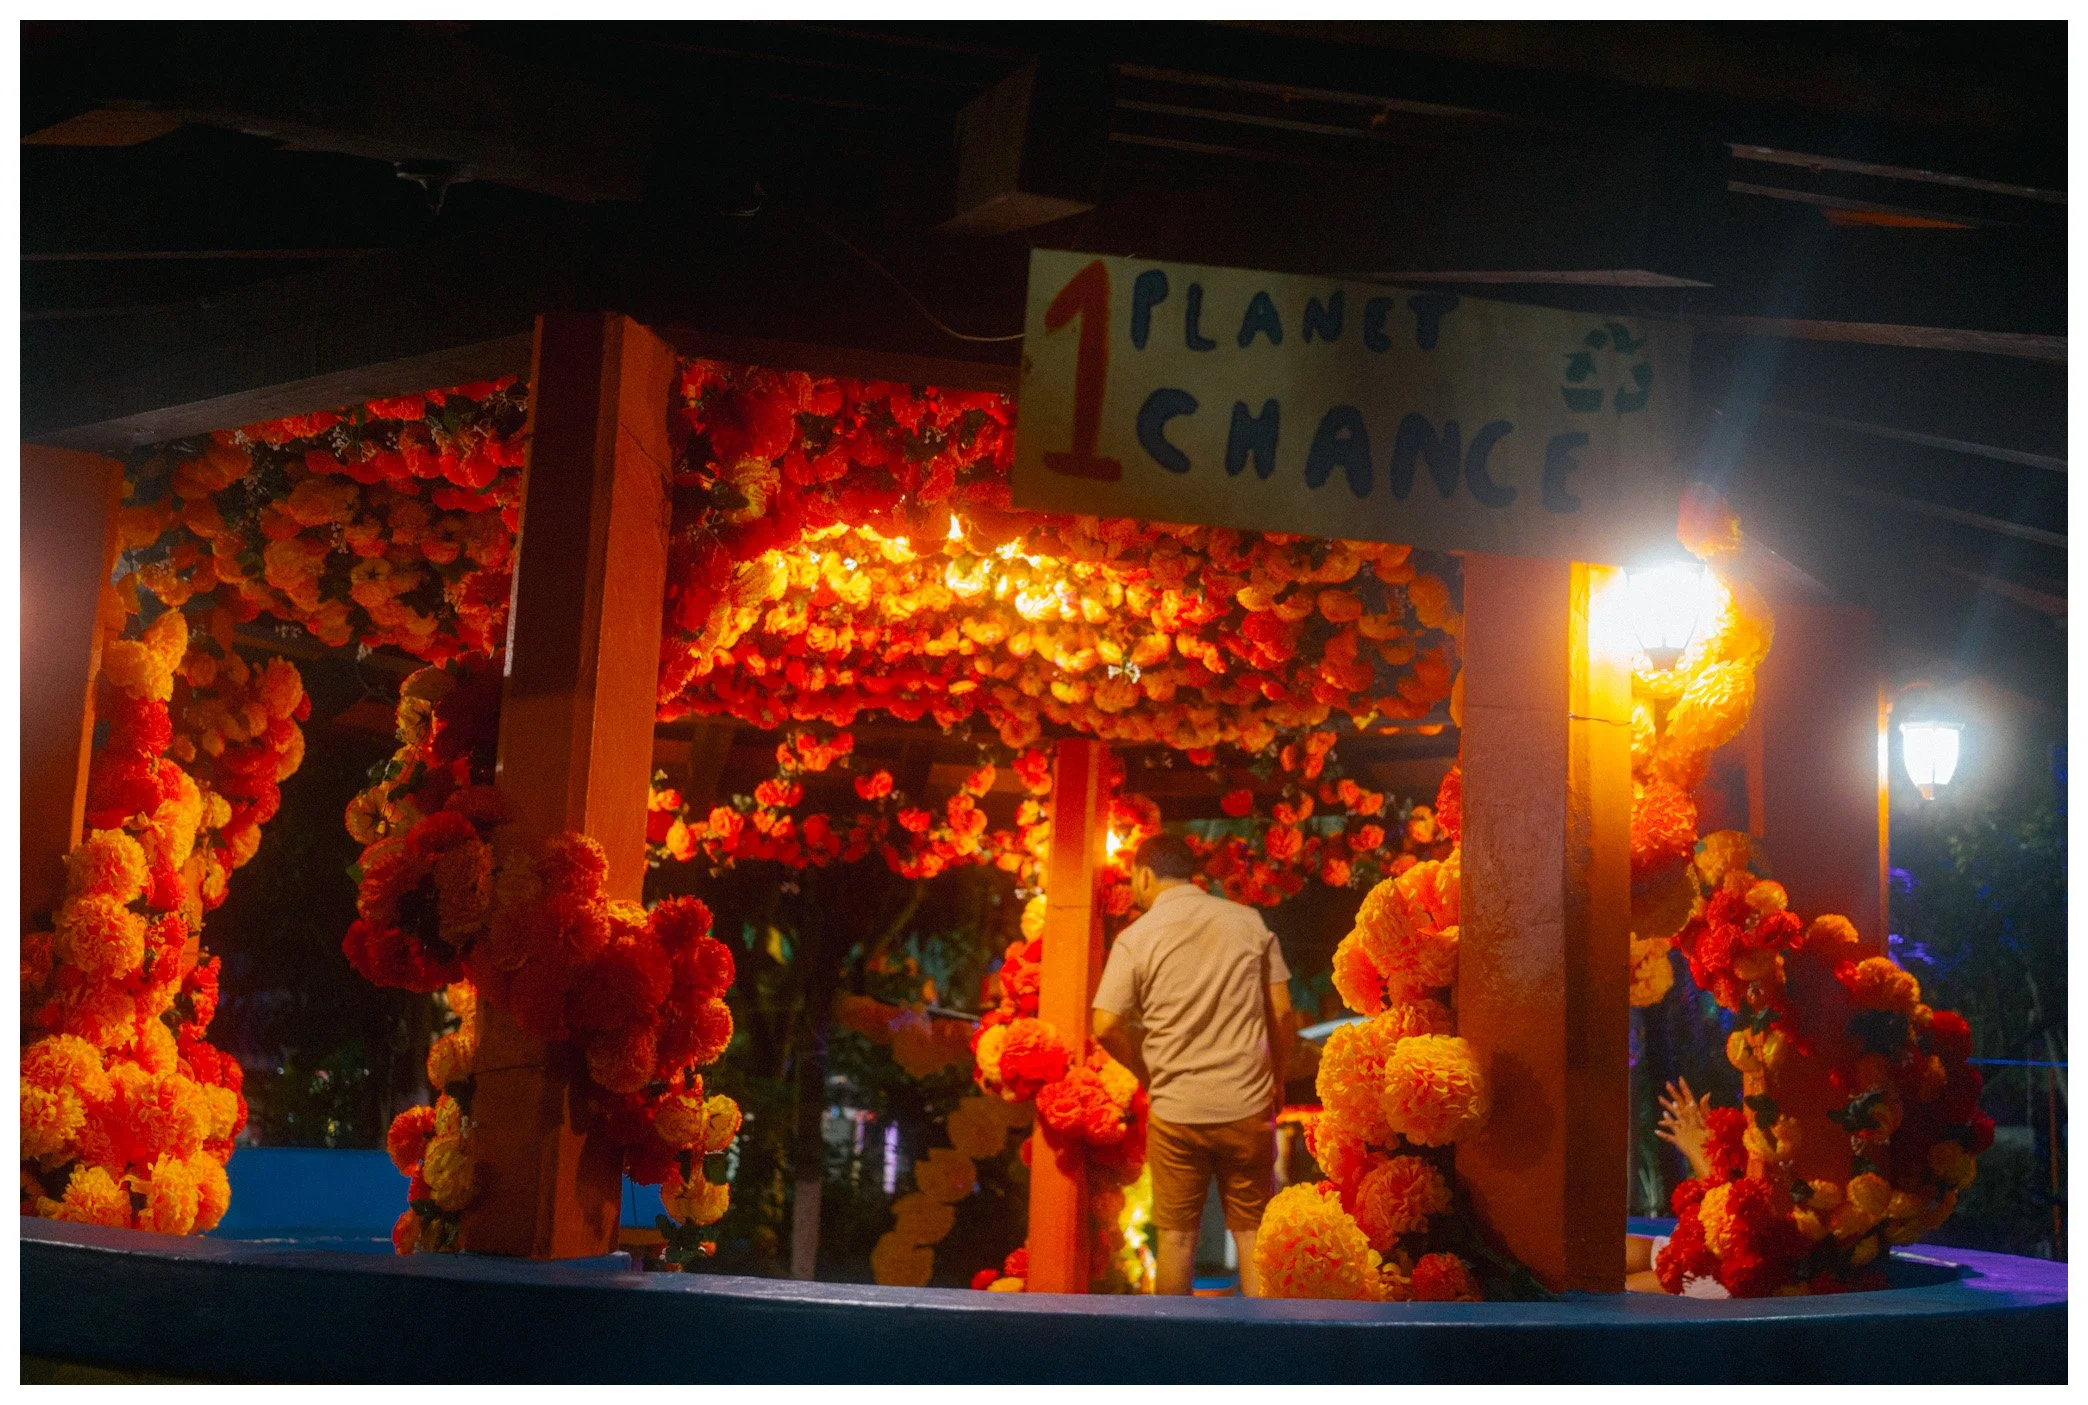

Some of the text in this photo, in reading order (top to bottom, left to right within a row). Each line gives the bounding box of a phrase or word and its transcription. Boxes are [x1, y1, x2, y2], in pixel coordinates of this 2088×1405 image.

[1044, 260, 1122, 482] 1
[1130, 269, 1457, 351] PLANET
[1136, 388, 1590, 514] CHANCE
